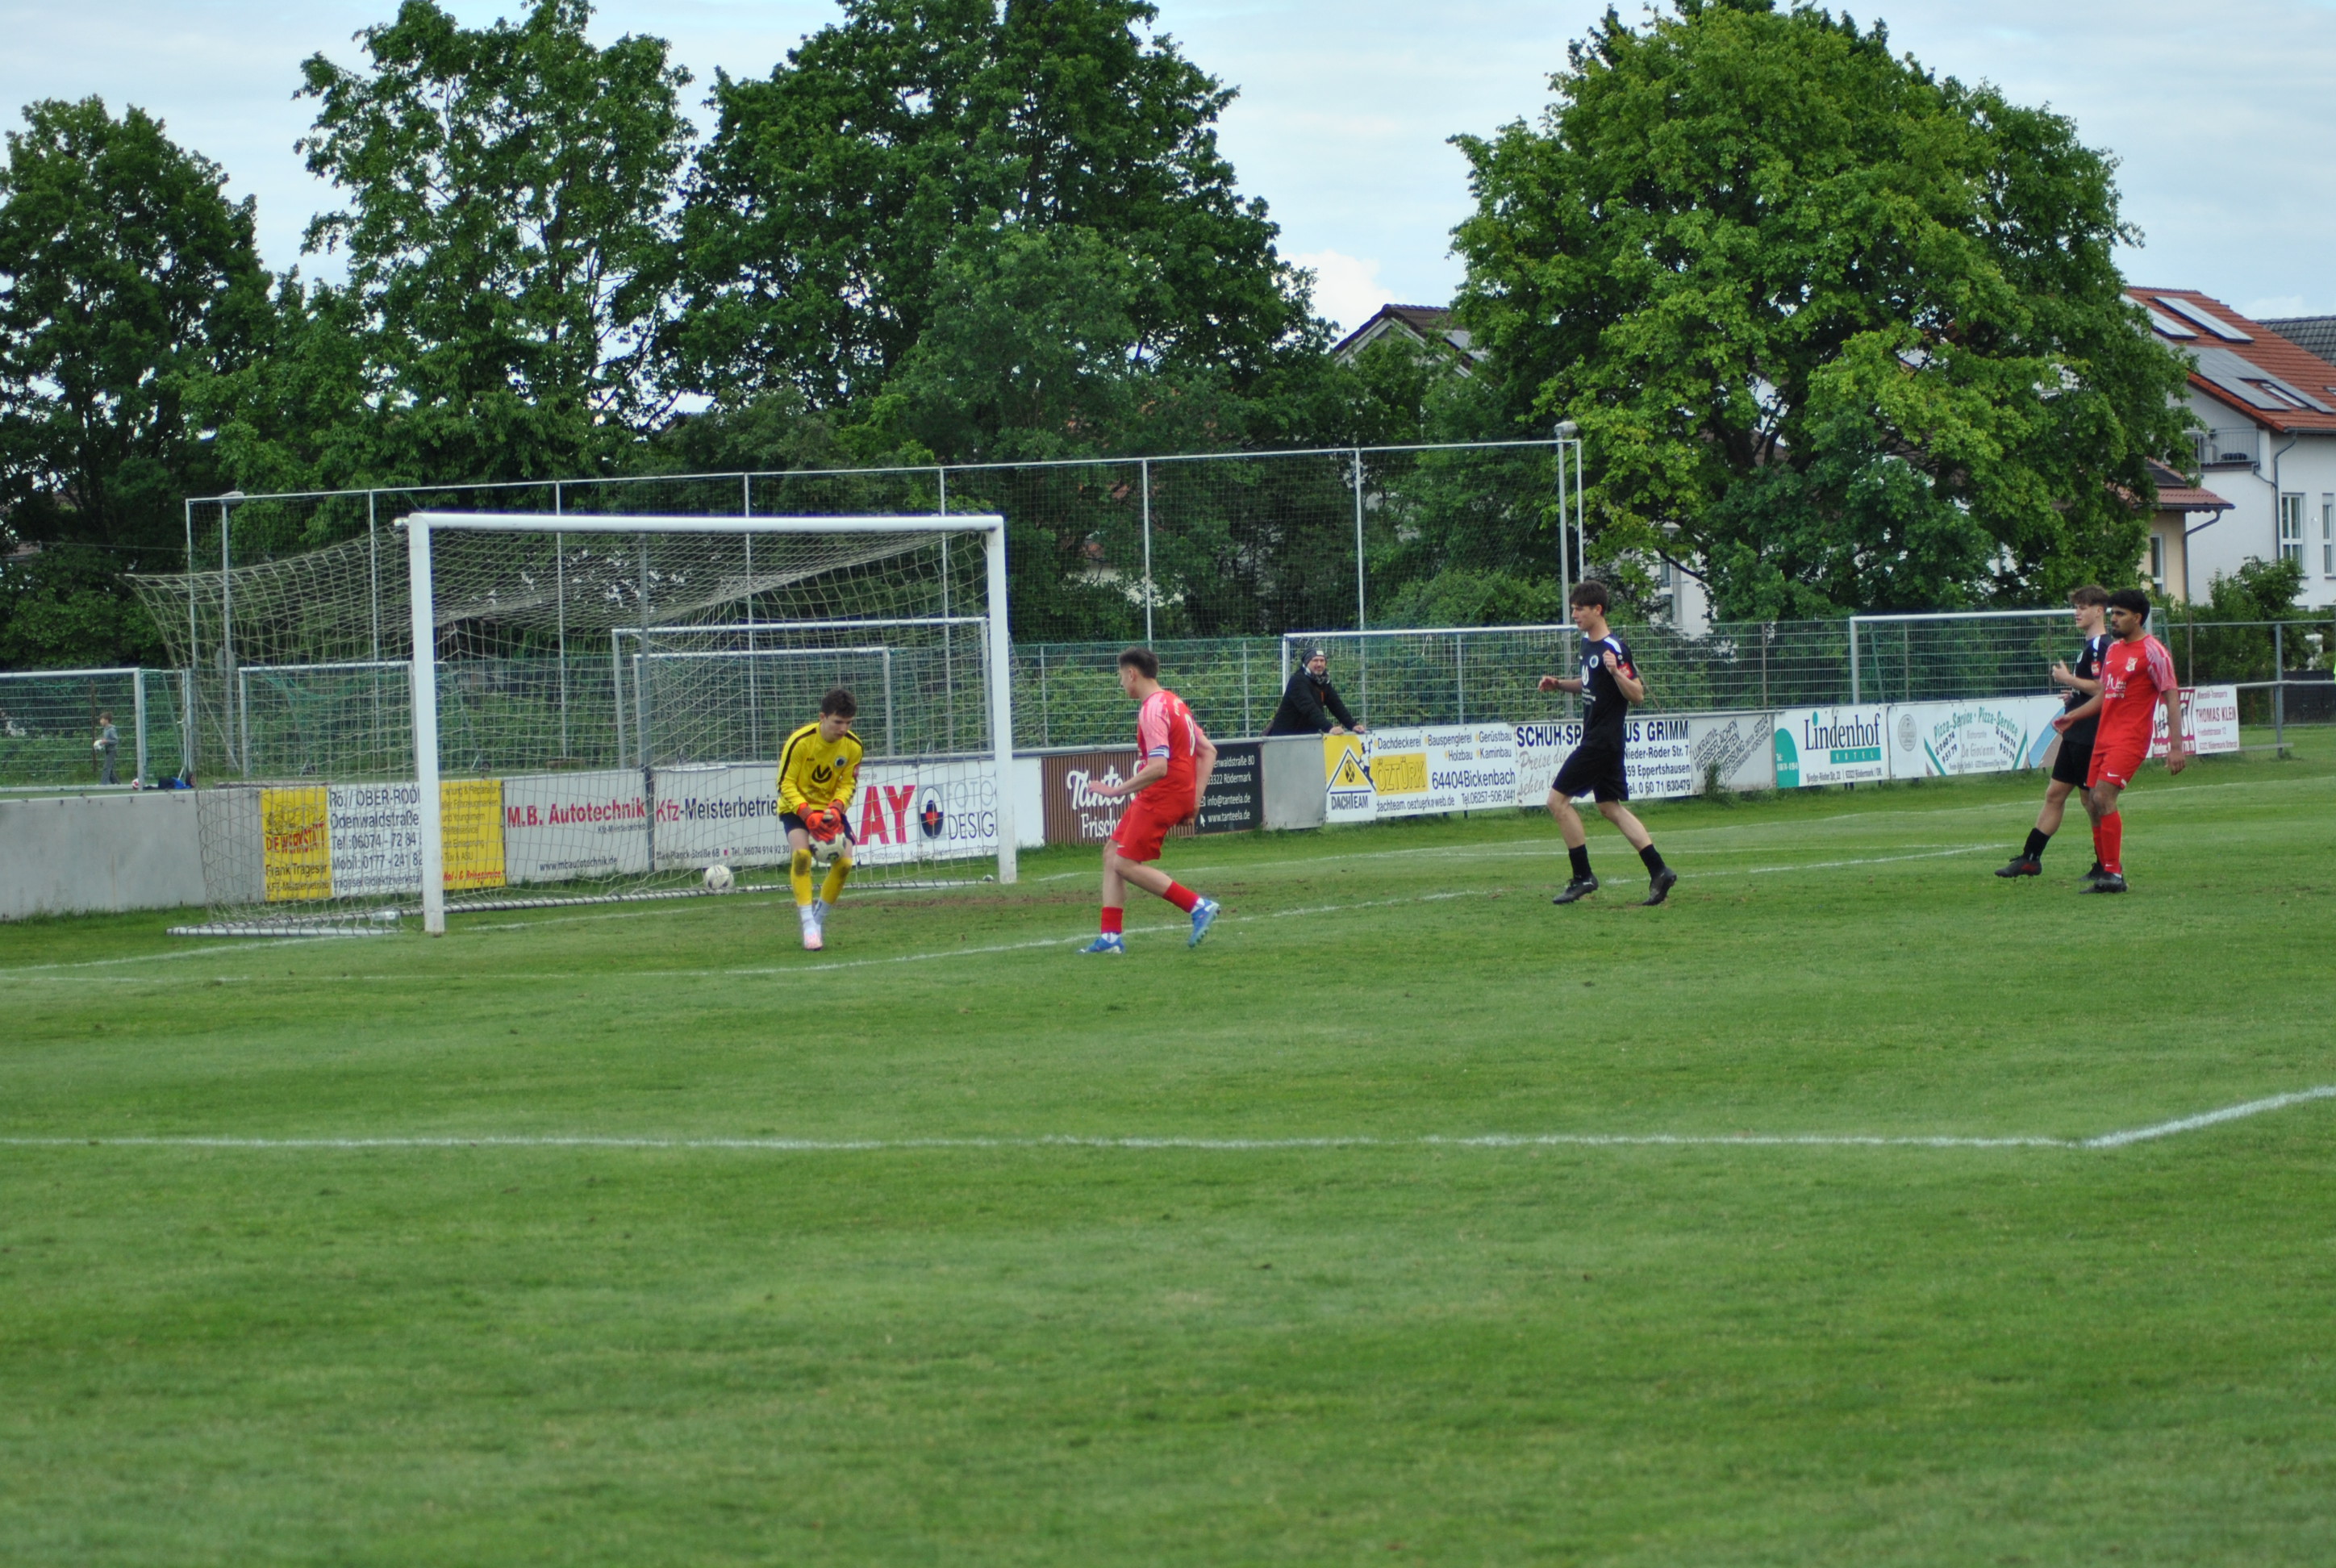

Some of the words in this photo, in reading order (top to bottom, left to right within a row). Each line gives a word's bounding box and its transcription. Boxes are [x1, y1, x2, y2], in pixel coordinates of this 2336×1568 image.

[1979, 706, 2018, 737] Pizza-Service
[2196, 707, 2220, 723] THOMAS
[2221, 706, 2237, 721] KLEIN
[1516, 724, 1582, 748] SCHUH-SP
[1647, 720, 1688, 741] GRIMM
[1804, 711, 1881, 750] Lindenhof
[1378, 736, 1421, 749] Dachdeckerei
[1428, 732, 1472, 748] Bauspenglerei
[1479, 731, 1512, 743] Gerüstbau
[1712, 730, 1740, 762] ERMIETEN
[1449, 749, 1473, 761] Holzbau
[1480, 746, 1512, 759] Kaminbau
[1672, 744, 1683, 757] Str.
[1685, 744, 1689, 756] 7
[1836, 751, 1874, 761] HOTEL
[1213, 755, 1247, 768] enwaldstraße
[1248, 754, 1255, 765] 80
[1224, 771, 1251, 784] Rödermark
[1376, 757, 1426, 792] ÖZTÜRK
[1637, 762, 1690, 779] Eppertshausen
[357, 787, 420, 807] OBER-ROD
[1207, 792, 1251, 807] info@tanteela.de
[1331, 792, 1369, 811] DACHTEAM
[507, 805, 544, 828] M.B.
[549, 797, 646, 825] Autotechnik
[656, 795, 777, 822] Kfz-Meisterbetrie
[1208, 809, 1250, 823] www.tanteela.de
[331, 810, 419, 829] Odenwaldstraße
[948, 811, 998, 840] DESIG
[265, 864, 290, 877] Frank
[292, 862, 328, 878] Trageser
